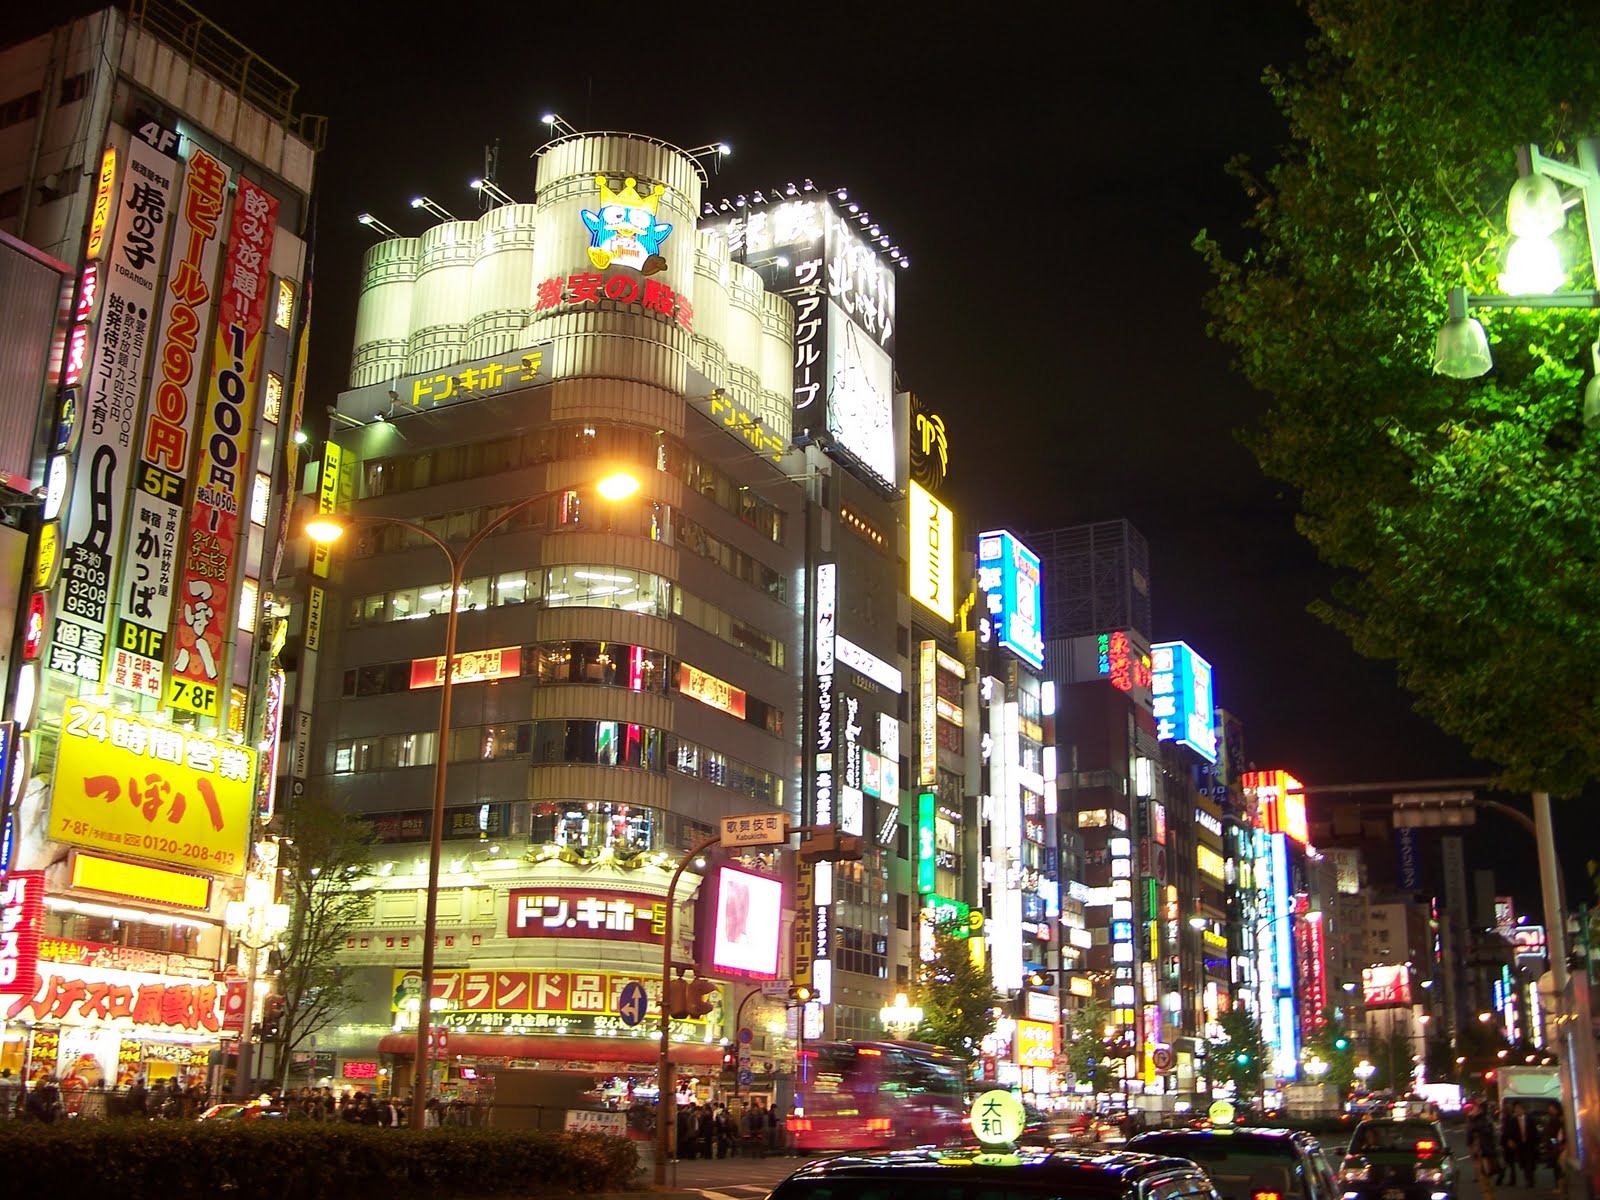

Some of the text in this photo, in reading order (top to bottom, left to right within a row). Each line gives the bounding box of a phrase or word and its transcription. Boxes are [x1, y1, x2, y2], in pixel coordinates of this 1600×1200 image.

[140, 121, 176, 152] 4F
[121, 181, 166, 271] 虎の子
[147, 150, 225, 472] 生ビール290円
[534, 271, 694, 333] 激安の殿堂
[795, 258, 822, 410] ヴィアグループ
[144, 467, 181, 499] 5F
[140, 507, 162, 529] 新宿
[158, 506, 179, 598] 平成の一杯飲み屋
[192, 544, 226, 571] サービス
[193, 530, 219, 552] タイム
[75, 547, 102, 570] 予約
[134, 527, 161, 620] かっぱ
[189, 561, 225, 583] いろいろ
[69, 579, 107, 604] 3208
[86, 568, 106, 587] 03
[66, 596, 103, 621] 9531
[56, 620, 105, 656] 個室
[122, 623, 163, 657] B1F
[174, 580, 216, 680] つぼ八
[50, 647, 102, 681] 完備
[66, 703, 251, 784] 24時間営業
[296, 740, 316, 777] TRAVEL
[83, 772, 225, 833] つぼ八
[727, 816, 778, 834] 歌舞伎町
[736, 831, 769, 842] Kabukicho
[142, 837, 236, 869] 0120-208-413
[795, 857, 812, 979] ドン・キホーテ
[981, 1098, 1002, 1137] 大和
